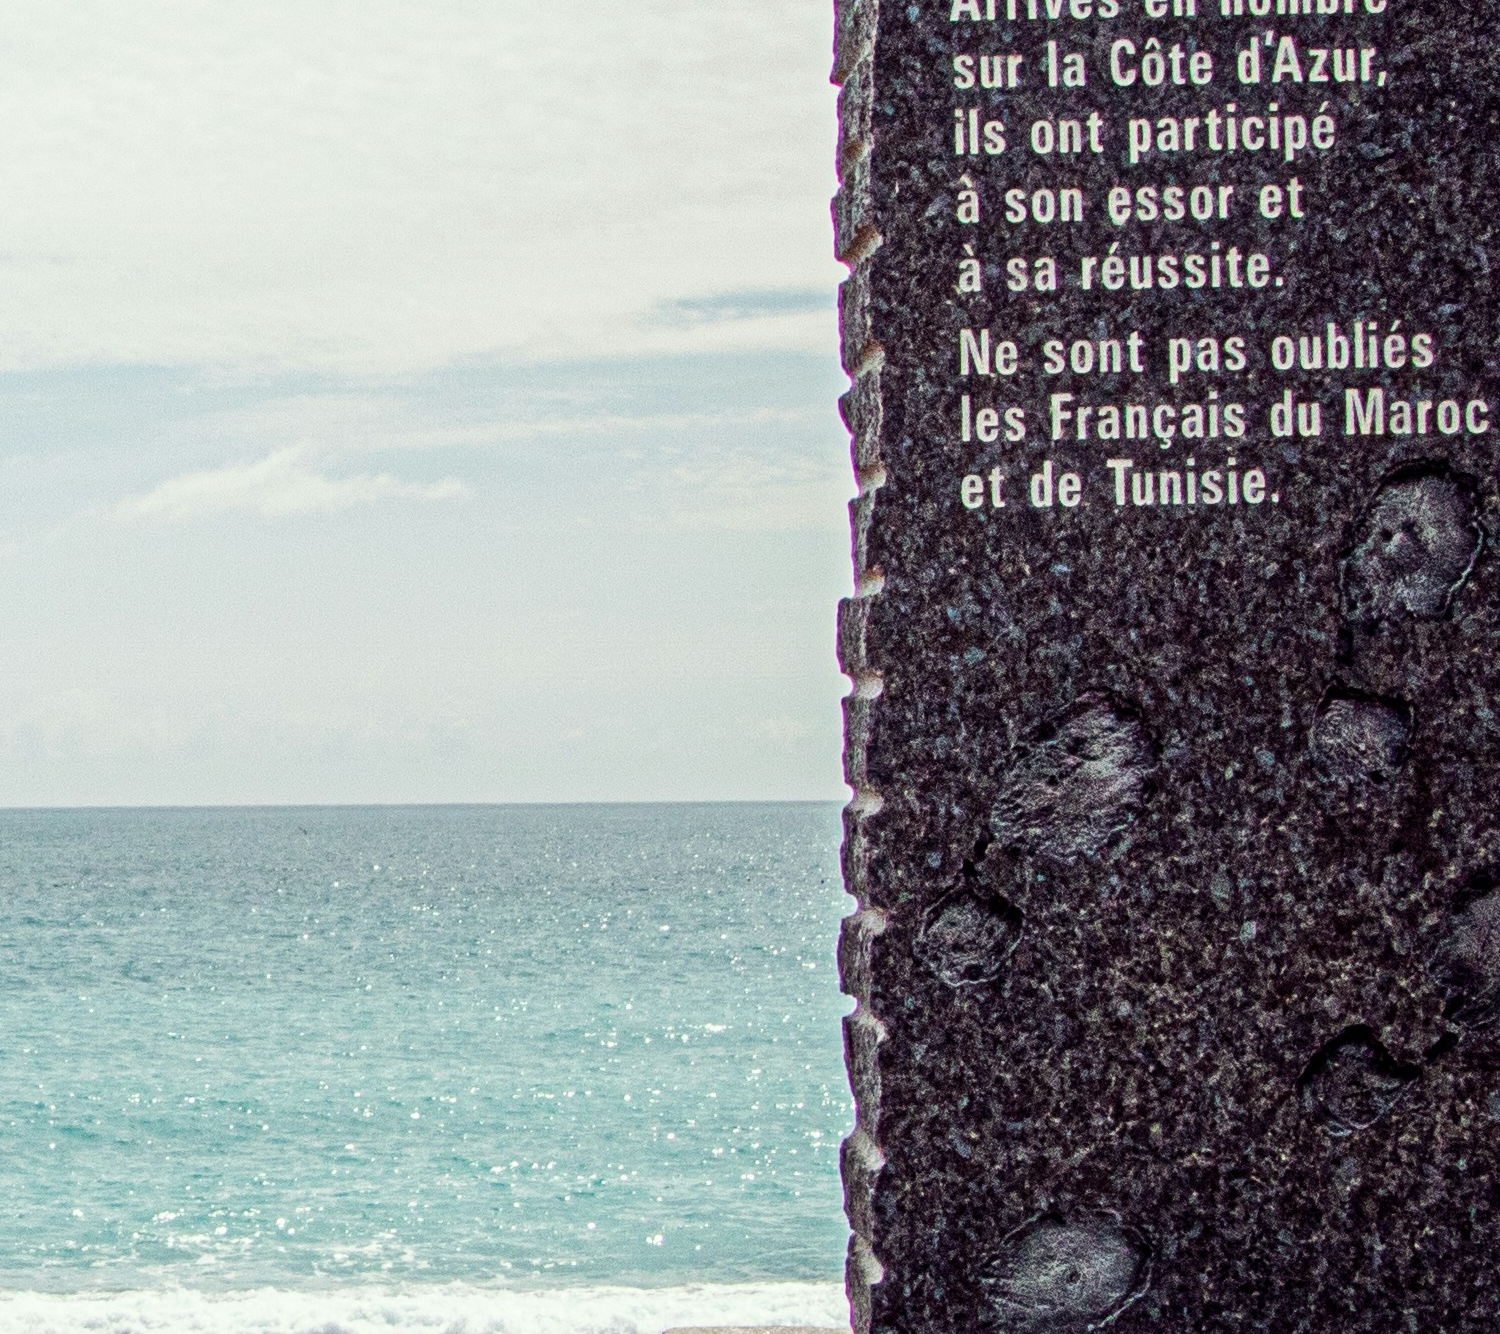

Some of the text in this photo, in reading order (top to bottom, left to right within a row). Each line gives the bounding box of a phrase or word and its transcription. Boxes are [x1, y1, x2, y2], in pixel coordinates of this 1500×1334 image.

[953, 30, 1387, 90] sur la Côte d'Azur,
[954, 100, 1335, 164] ils ont participé
[956, 174, 1305, 226] à son essor et
[956, 241, 1285, 295] à sa réussite.
[960, 319, 1434, 385] Ne sont pas oubliés
[961, 388, 1489, 450] les Français du Maroc
[961, 456, 1280, 510] et de Tunisie.
